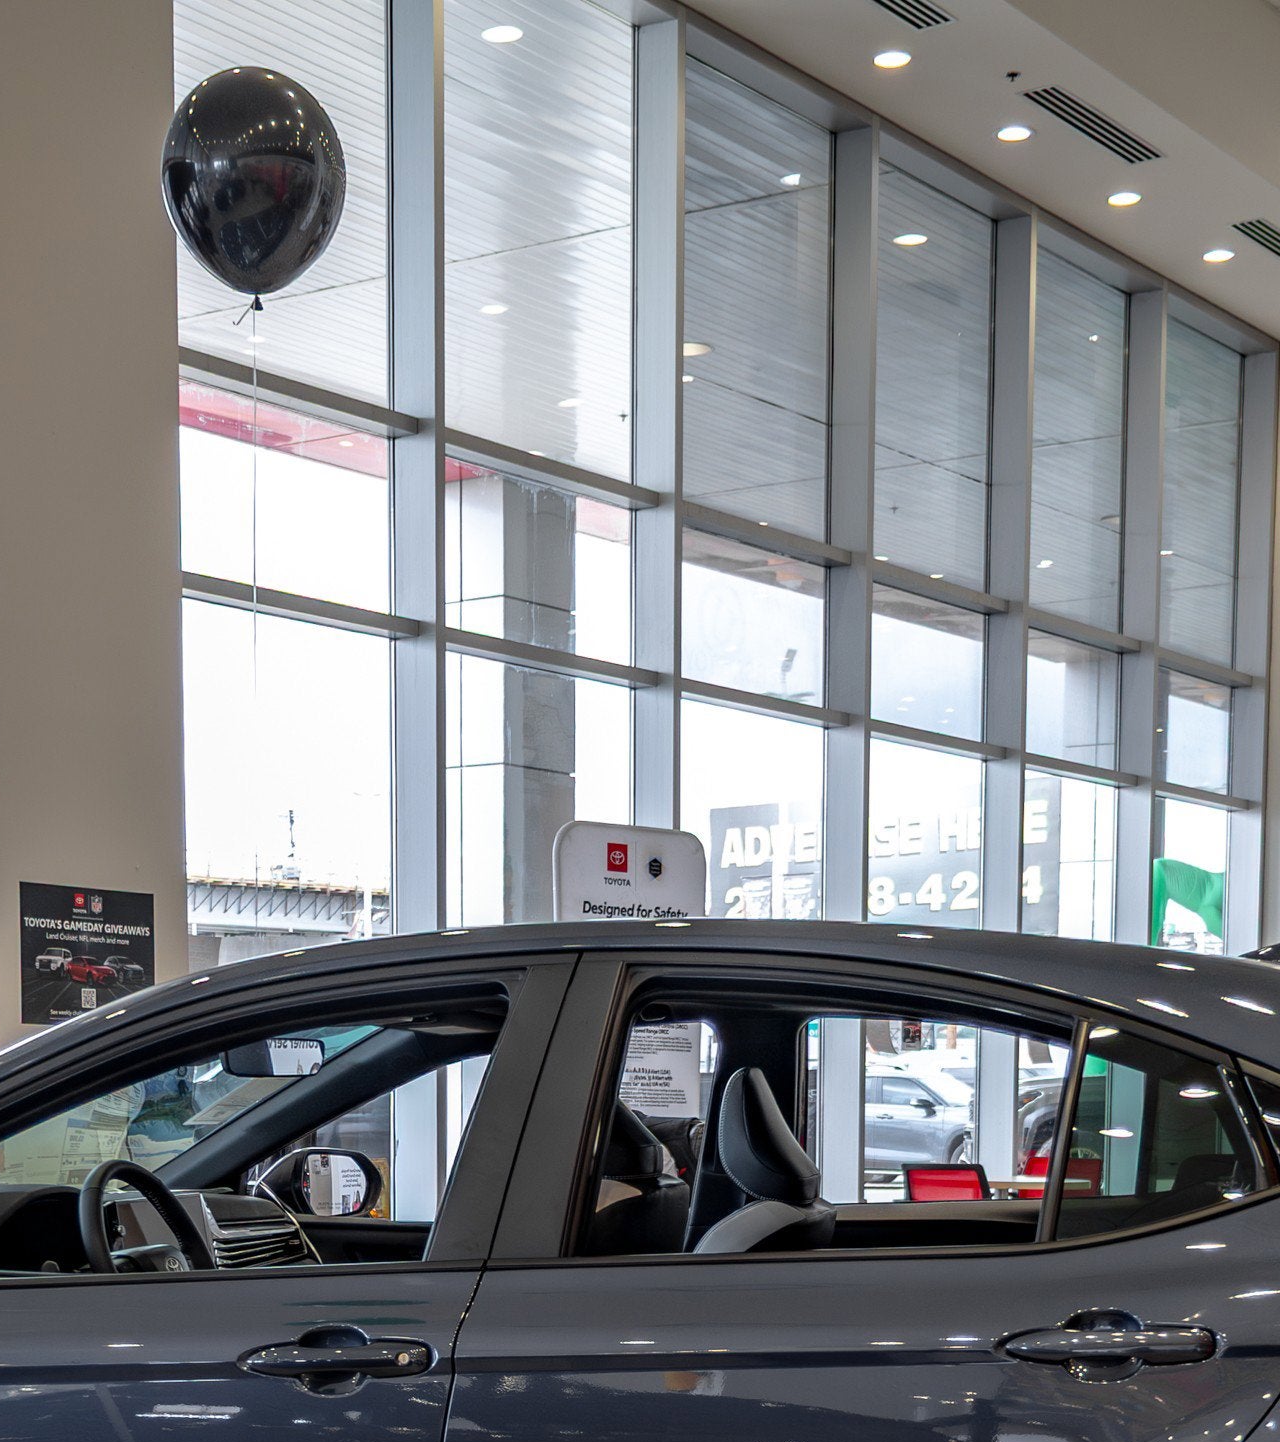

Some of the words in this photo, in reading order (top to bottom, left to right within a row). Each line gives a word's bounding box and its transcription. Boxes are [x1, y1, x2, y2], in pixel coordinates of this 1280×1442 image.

[604, 877, 631, 887] TOYOTA
[582, 900, 635, 918] Designed
[636, 904, 652, 918] for
[24, 917, 62, 929] TOYOTA'S
[63, 920, 103, 933] GAMEDAY
[104, 924, 150, 937] GIVEAWAYS
